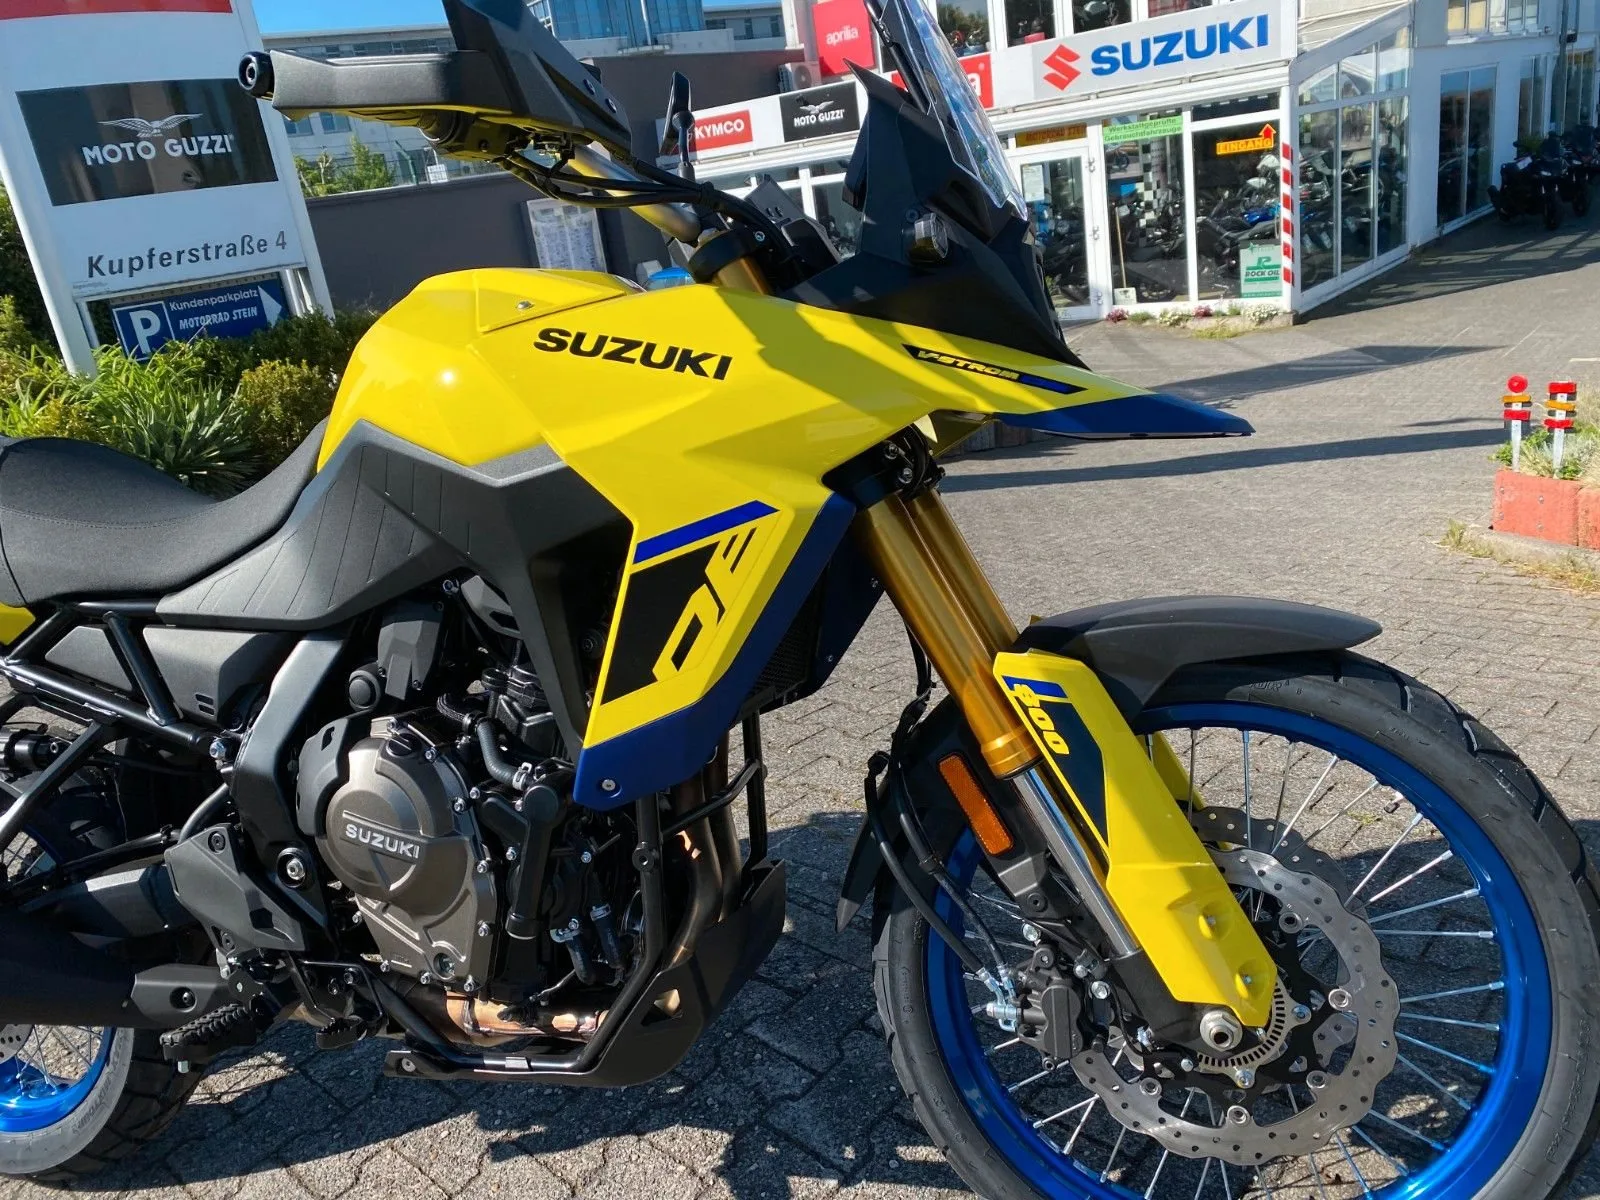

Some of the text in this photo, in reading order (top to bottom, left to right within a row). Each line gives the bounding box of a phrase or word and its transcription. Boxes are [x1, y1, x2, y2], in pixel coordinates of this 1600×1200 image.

[826, 25, 859, 46] aprilia
[1091, 14, 1269, 77] SUZUKI
[694, 118, 745, 139] KYMCO
[794, 109, 845, 128] MOTO GUZZI
[82, 134, 232, 166] MOTO GUZZI
[1219, 137, 1271, 153] EINGANG
[87, 230, 287, 278] Kupferstraße 4
[1245, 270, 1266, 278] ROCK
[169, 289, 258, 312] Kundenparkplatz
[129, 309, 161, 354] P
[179, 306, 258, 330] MOTORRAD STEIN
[533, 327, 732, 380] SUZUKI
[917, 350, 1020, 380] V-STROM
[1012, 683, 1070, 754] 800
[345, 823, 420, 859] SUZUKI
